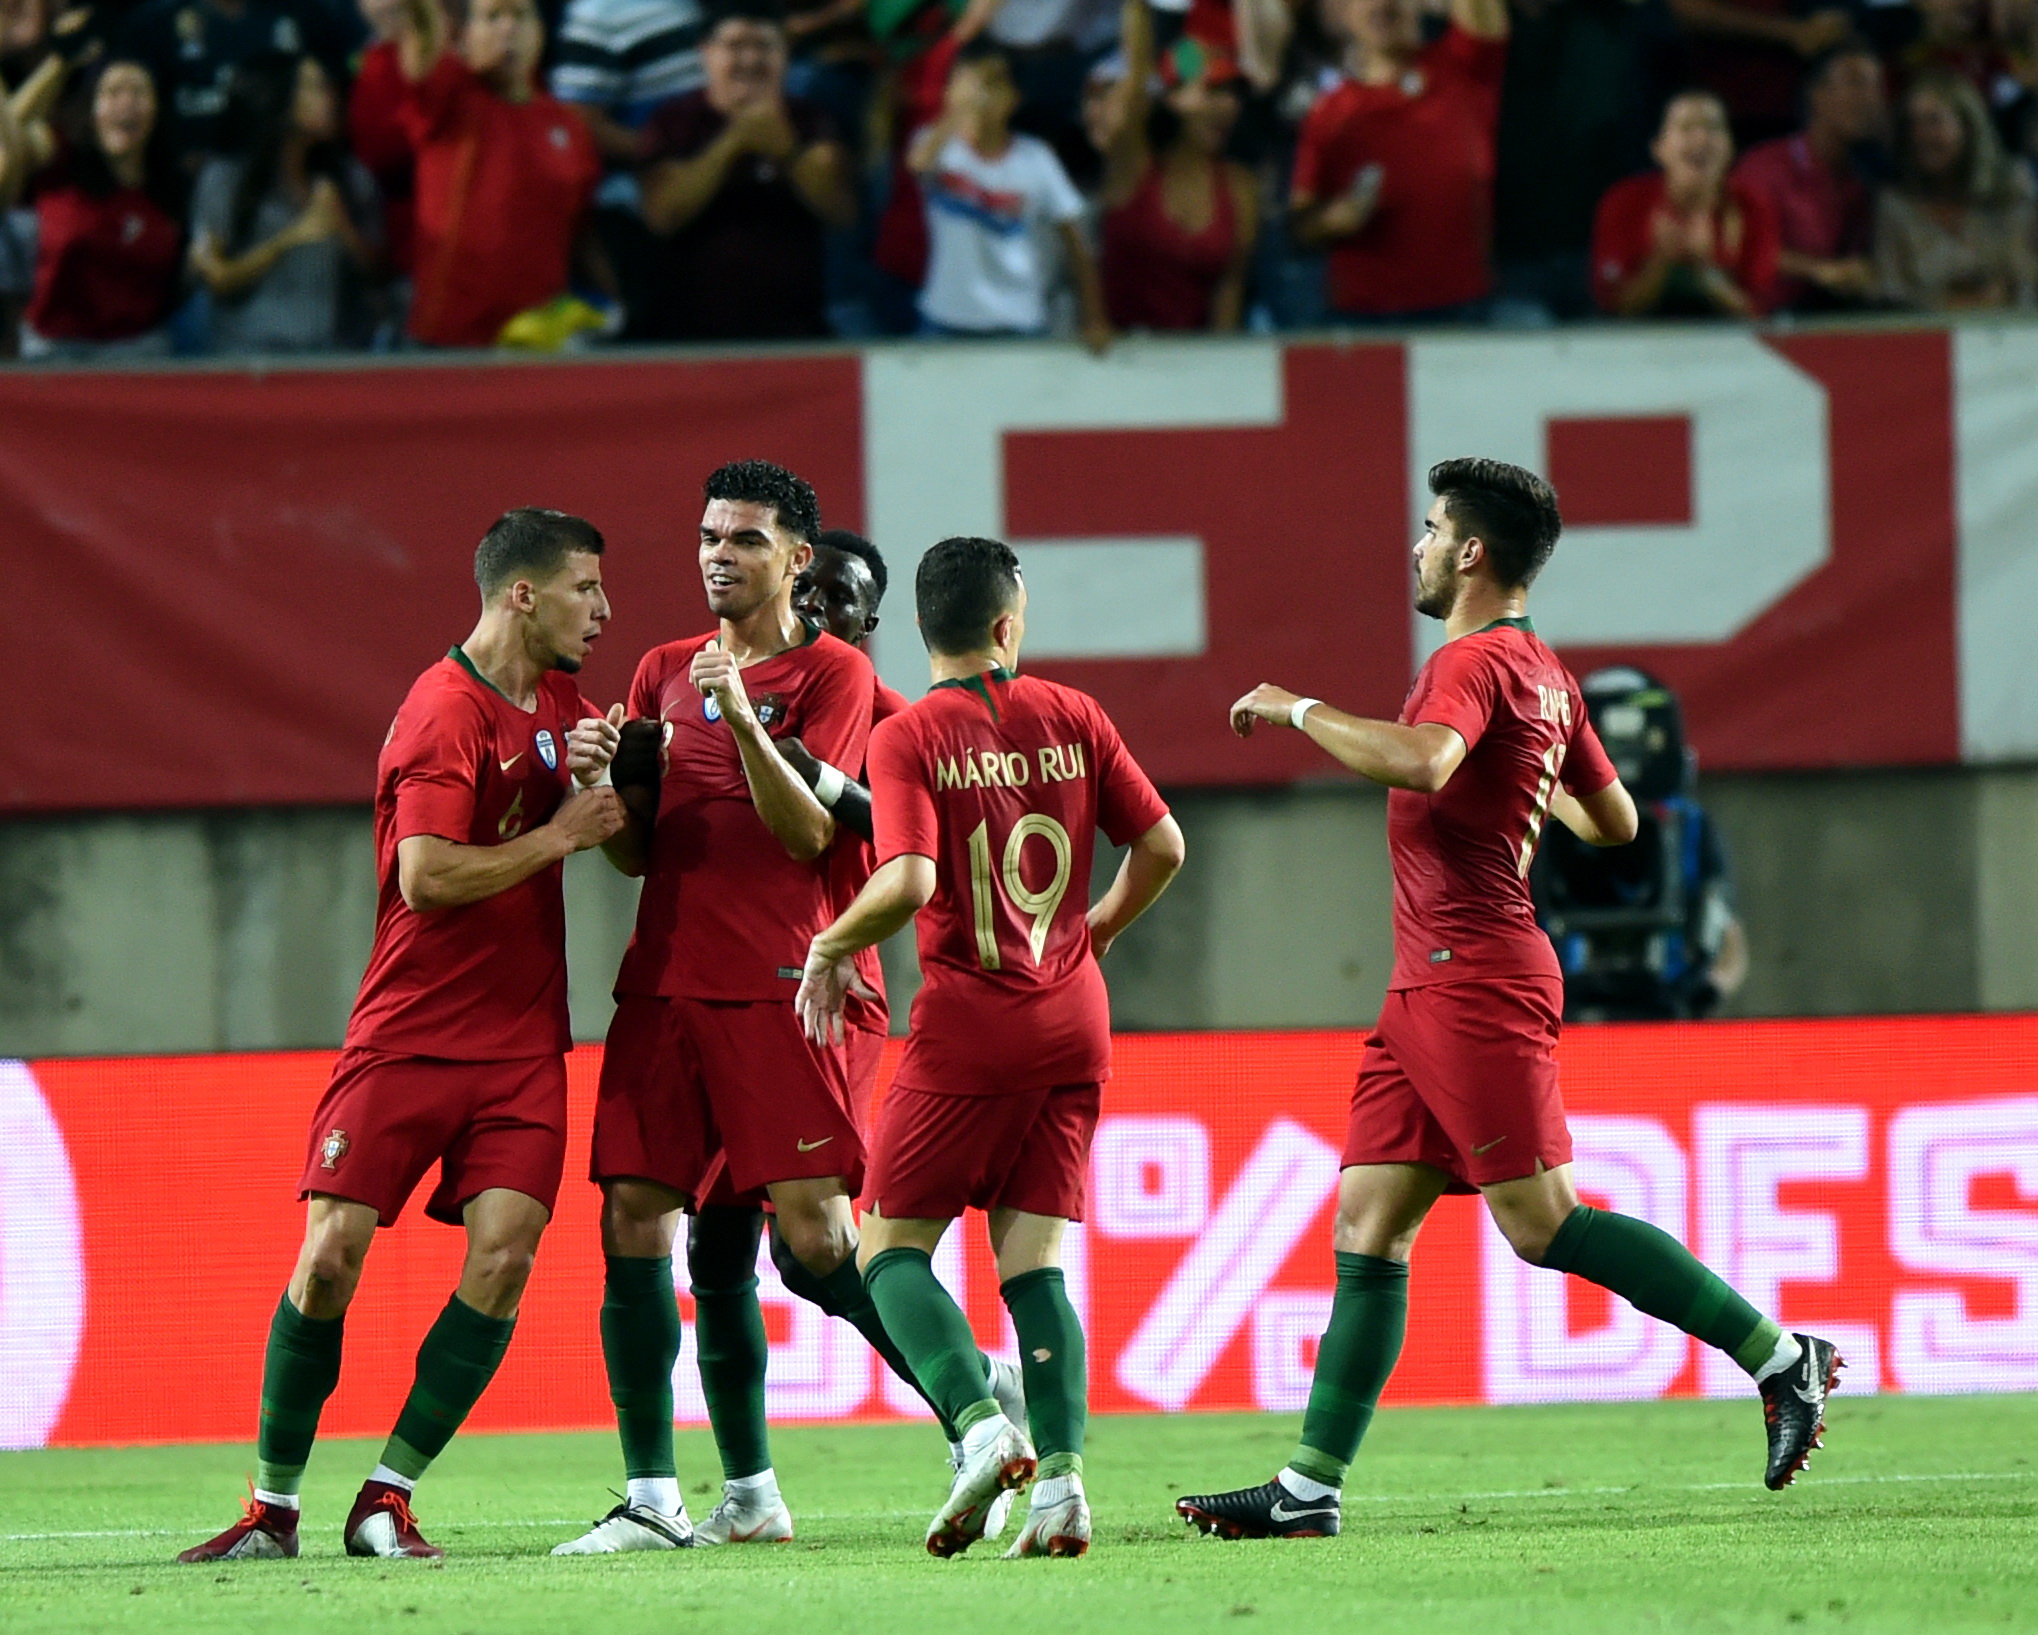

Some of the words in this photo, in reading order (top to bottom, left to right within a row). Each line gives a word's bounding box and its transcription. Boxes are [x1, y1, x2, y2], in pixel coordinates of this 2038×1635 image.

[864, 330, 2038, 766] FP
[498, 786, 523, 840] 6
[936, 747, 1030, 792] MÁRIO
[1038, 742, 1086, 784] RUI
[967, 812, 1072, 970] 19
